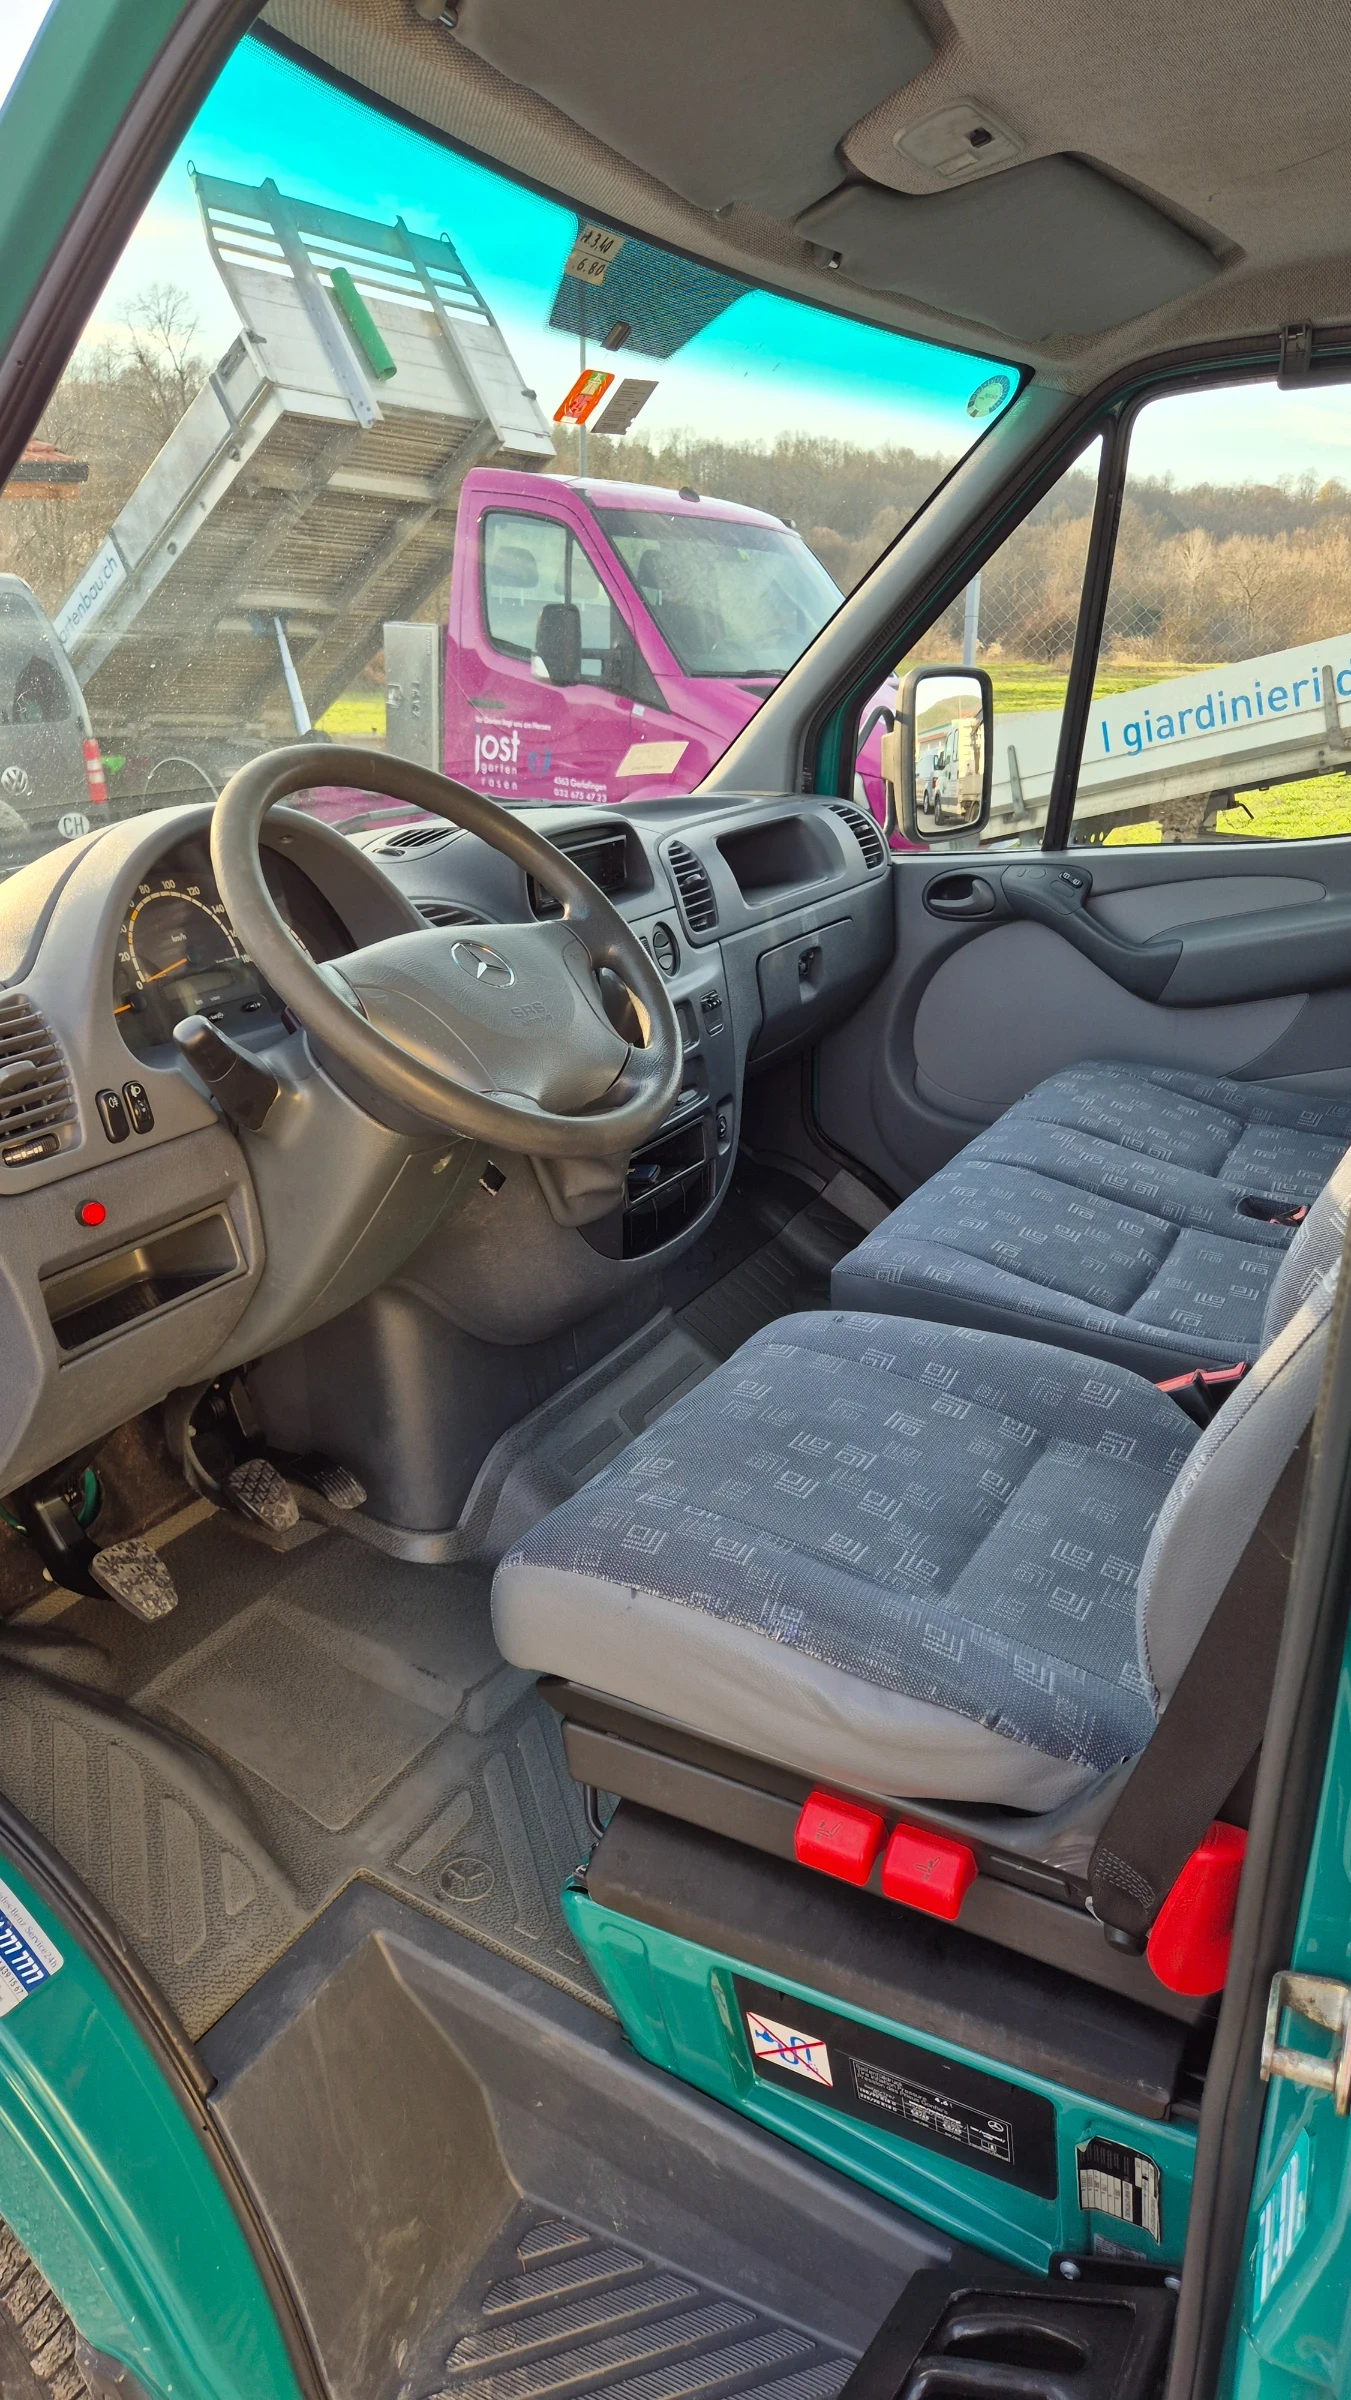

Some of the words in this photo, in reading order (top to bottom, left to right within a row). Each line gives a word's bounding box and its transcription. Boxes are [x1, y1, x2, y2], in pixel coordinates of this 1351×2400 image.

[1101, 720, 1111, 753] I
[1123, 666, 1321, 756] giardinieri
[475, 725, 520, 775] jost
[480, 762, 518, 775] garten
[481, 777, 518, 791] rasen
[63, 816, 84, 837] CH
[139, 884, 151, 895] 80
[161, 879, 176, 890] 100
[186, 886, 200, 896] 120
[211, 904, 225, 914] 140
[171, 932, 188, 943] km/h
[118, 951, 131, 963] 20
[135, 981, 144, 991] 0
[510, 1001, 548, 1018] SRS
[11, 1949, 45, 1985] 7777
[9, 1977, 18, 1988] 15
[13, 1985, 24, 1995] 67
